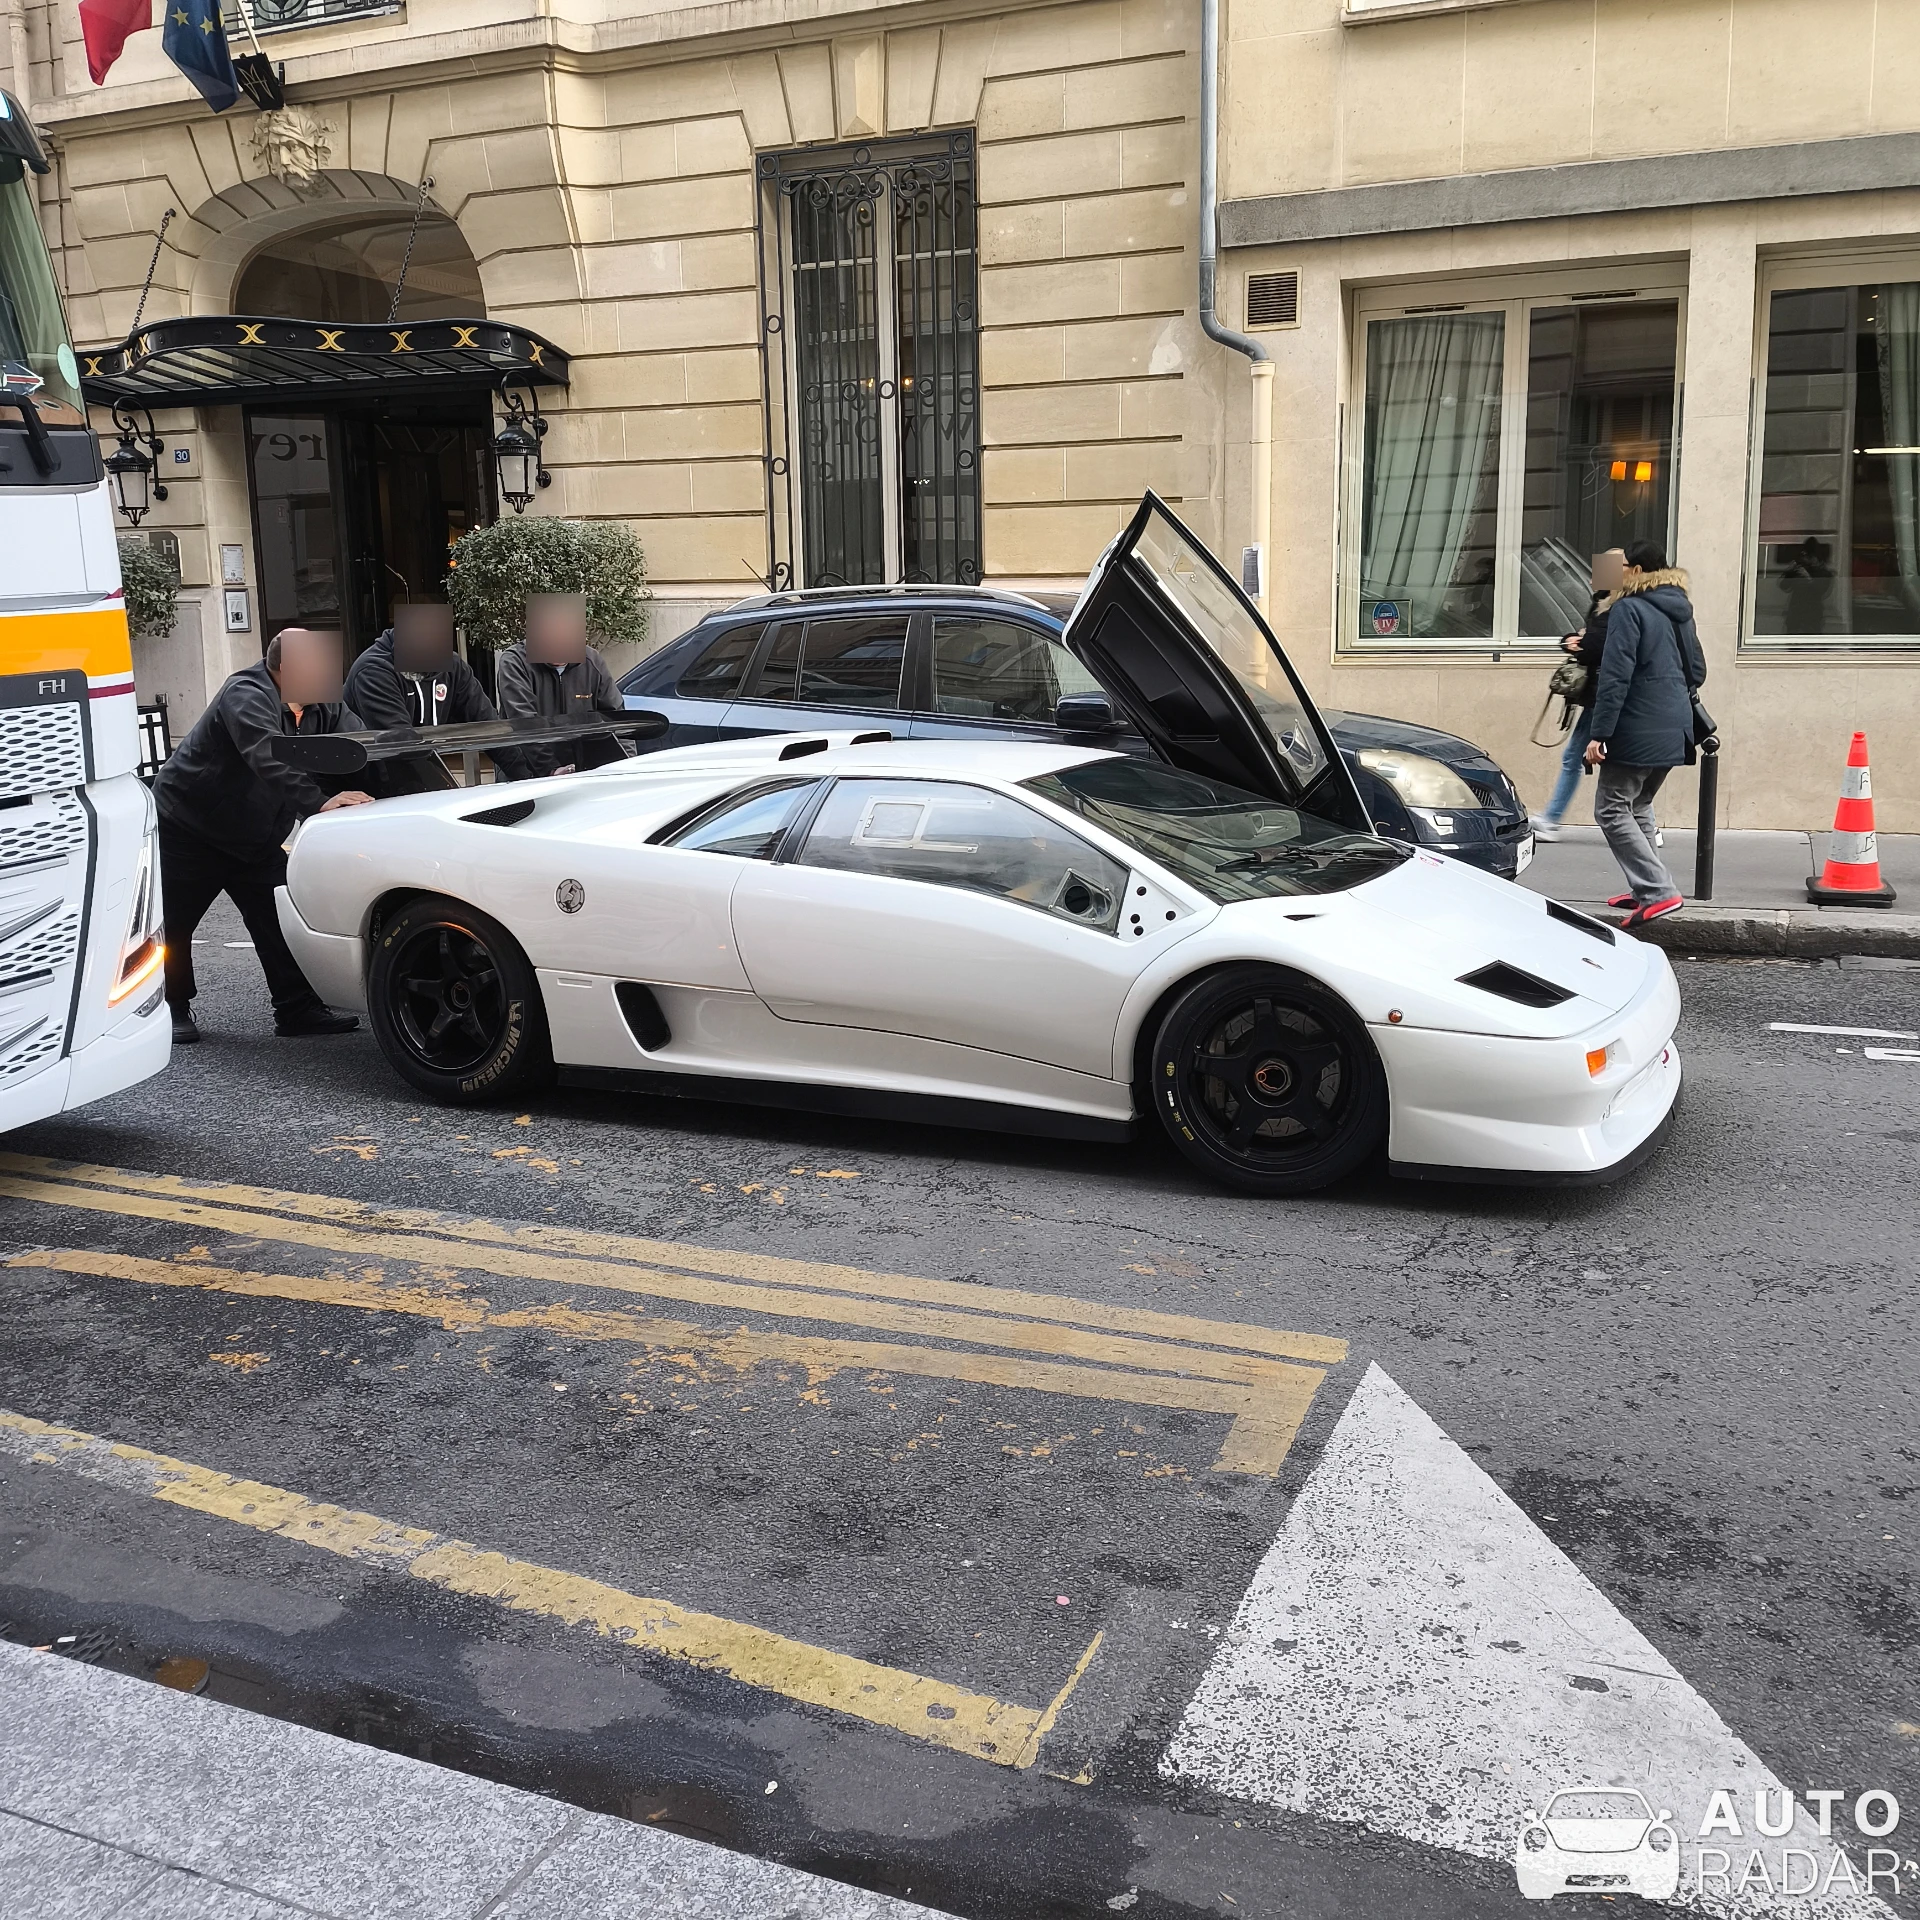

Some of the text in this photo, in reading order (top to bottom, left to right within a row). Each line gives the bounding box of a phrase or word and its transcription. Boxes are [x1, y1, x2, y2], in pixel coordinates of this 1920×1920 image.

[176, 450, 188, 461] 30
[162, 539, 176, 555] H
[38, 679, 66, 695] FH
[462, 1025, 521, 1093] MICHELIN
